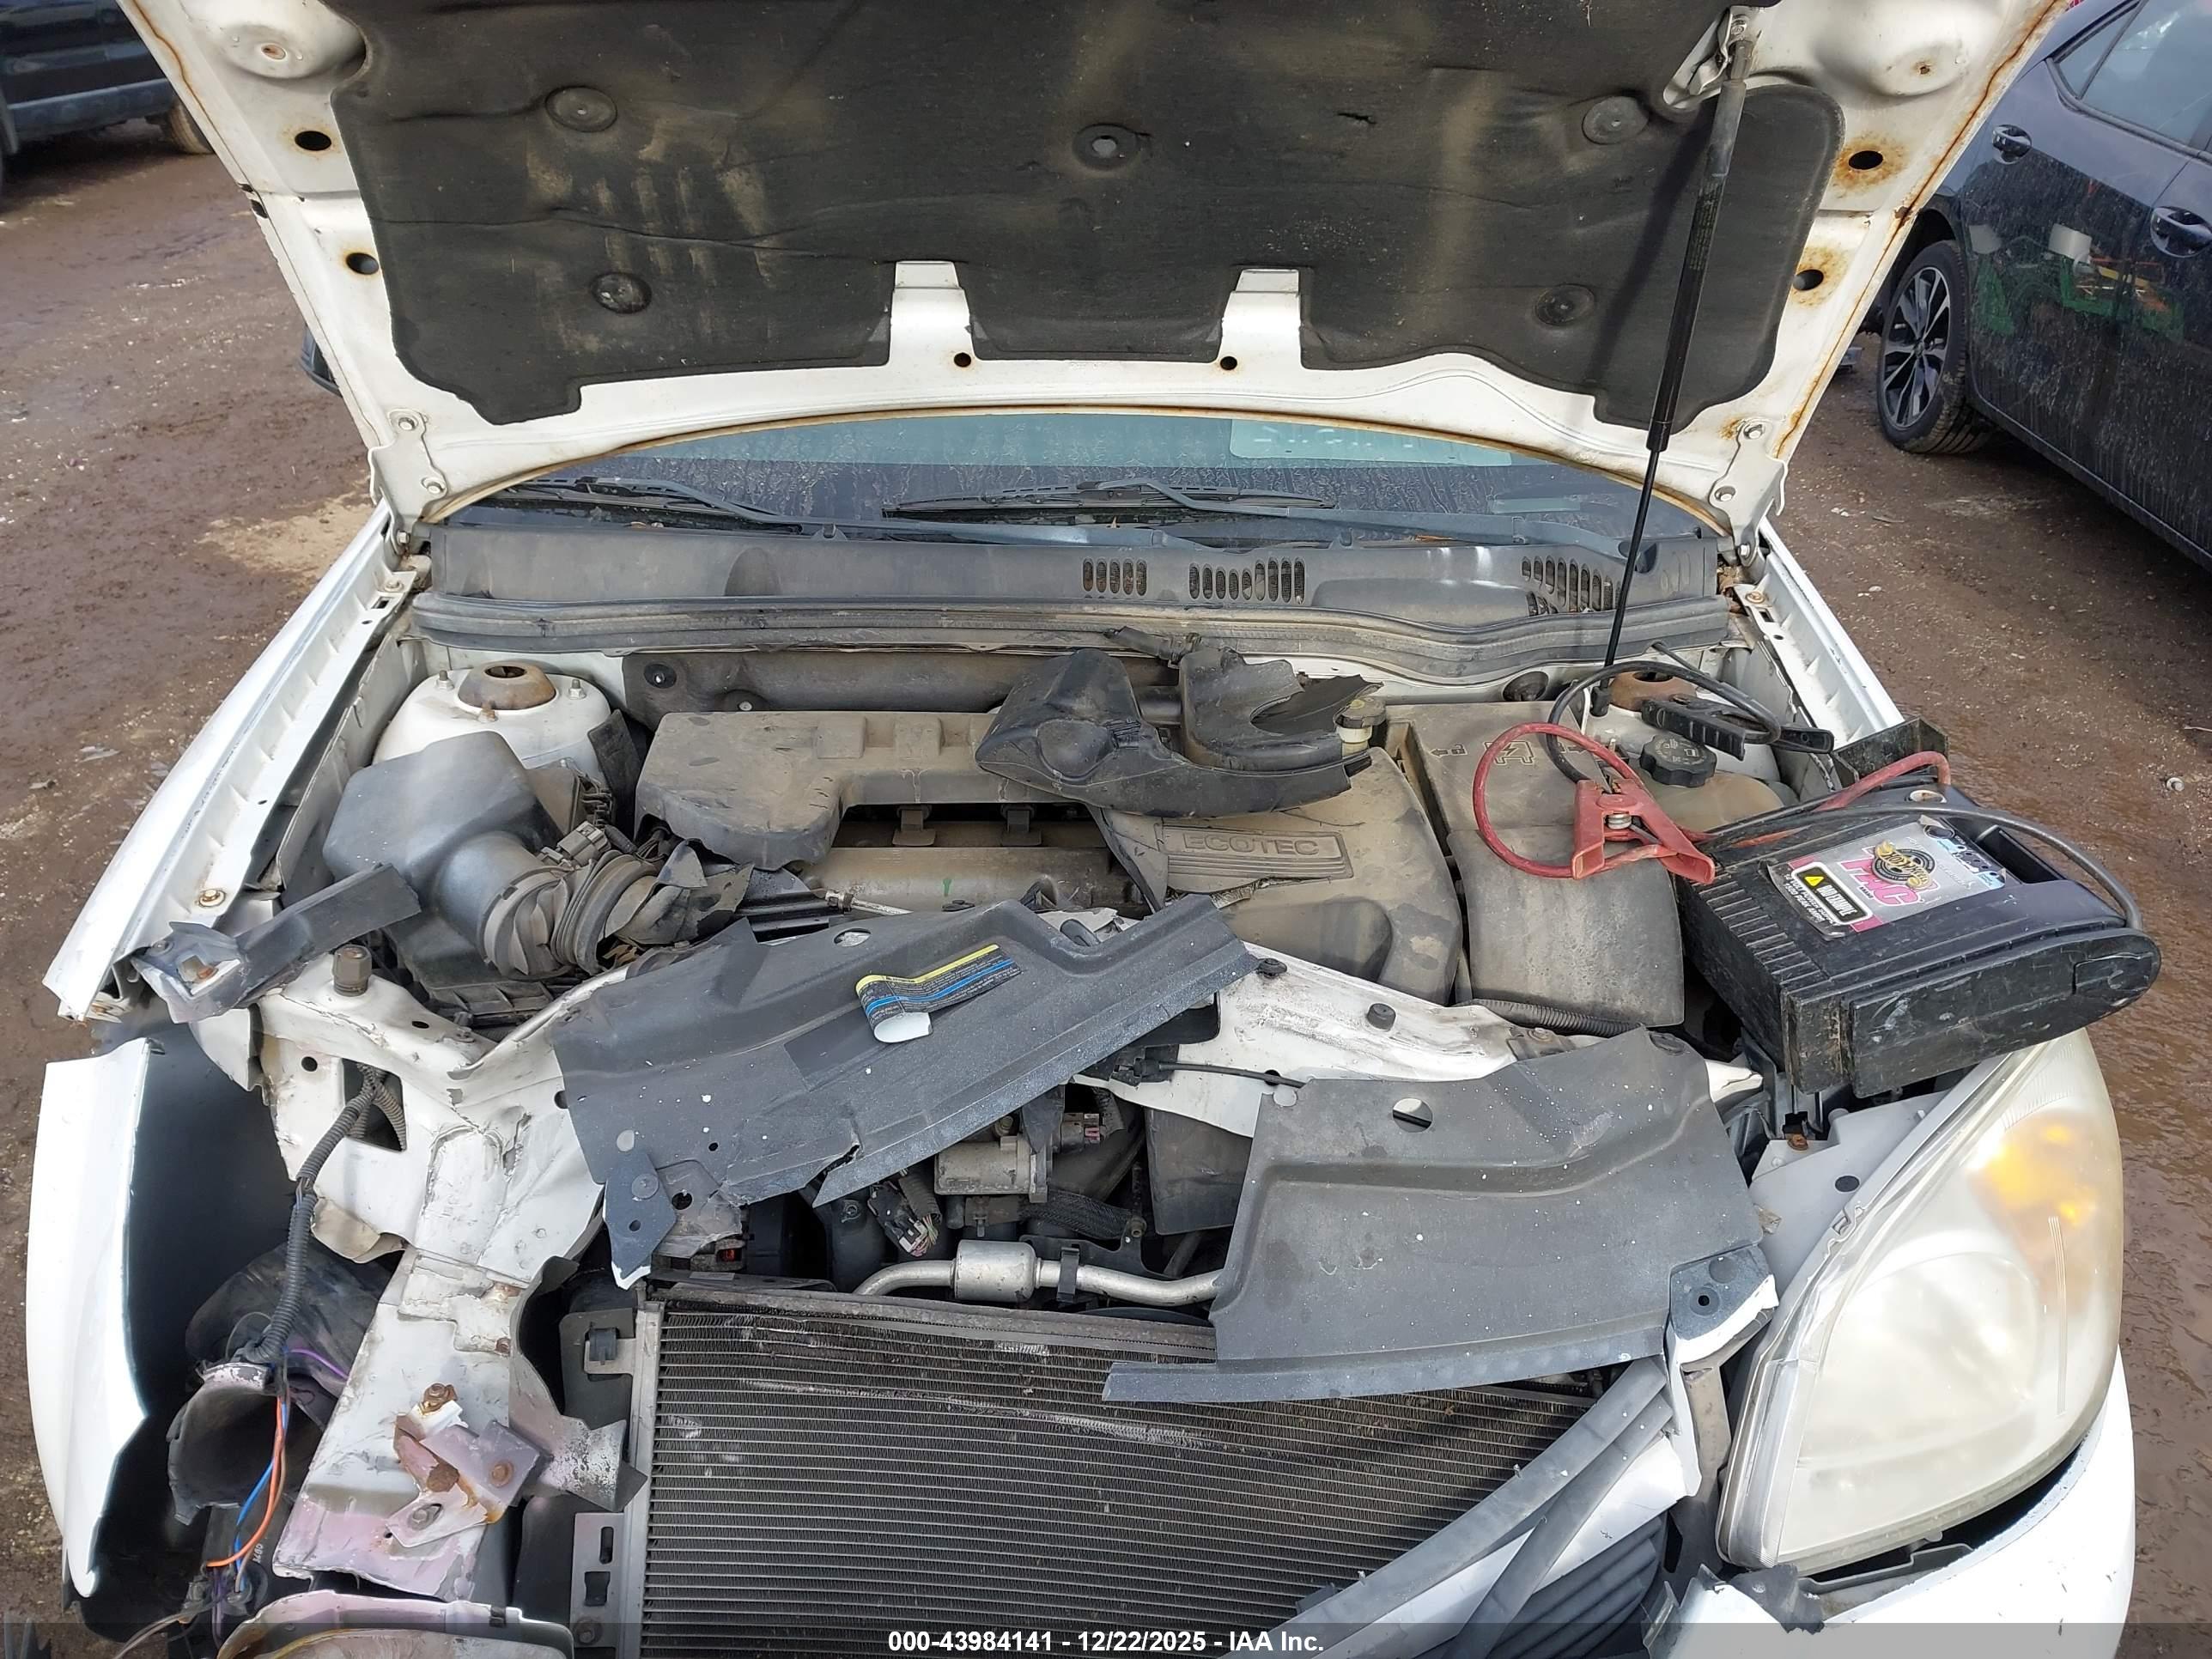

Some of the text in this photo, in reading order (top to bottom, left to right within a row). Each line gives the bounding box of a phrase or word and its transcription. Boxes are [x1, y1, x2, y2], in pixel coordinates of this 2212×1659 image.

[1182, 832, 1320, 855] ECOTEC
[1790, 879, 1804, 894] VOLT
[1803, 891, 1819, 908] POWER
[1816, 884, 1857, 917] BAD EXAMPLE
[1794, 895, 1811, 908] PEAK
[1807, 908, 1826, 922] AMPS
